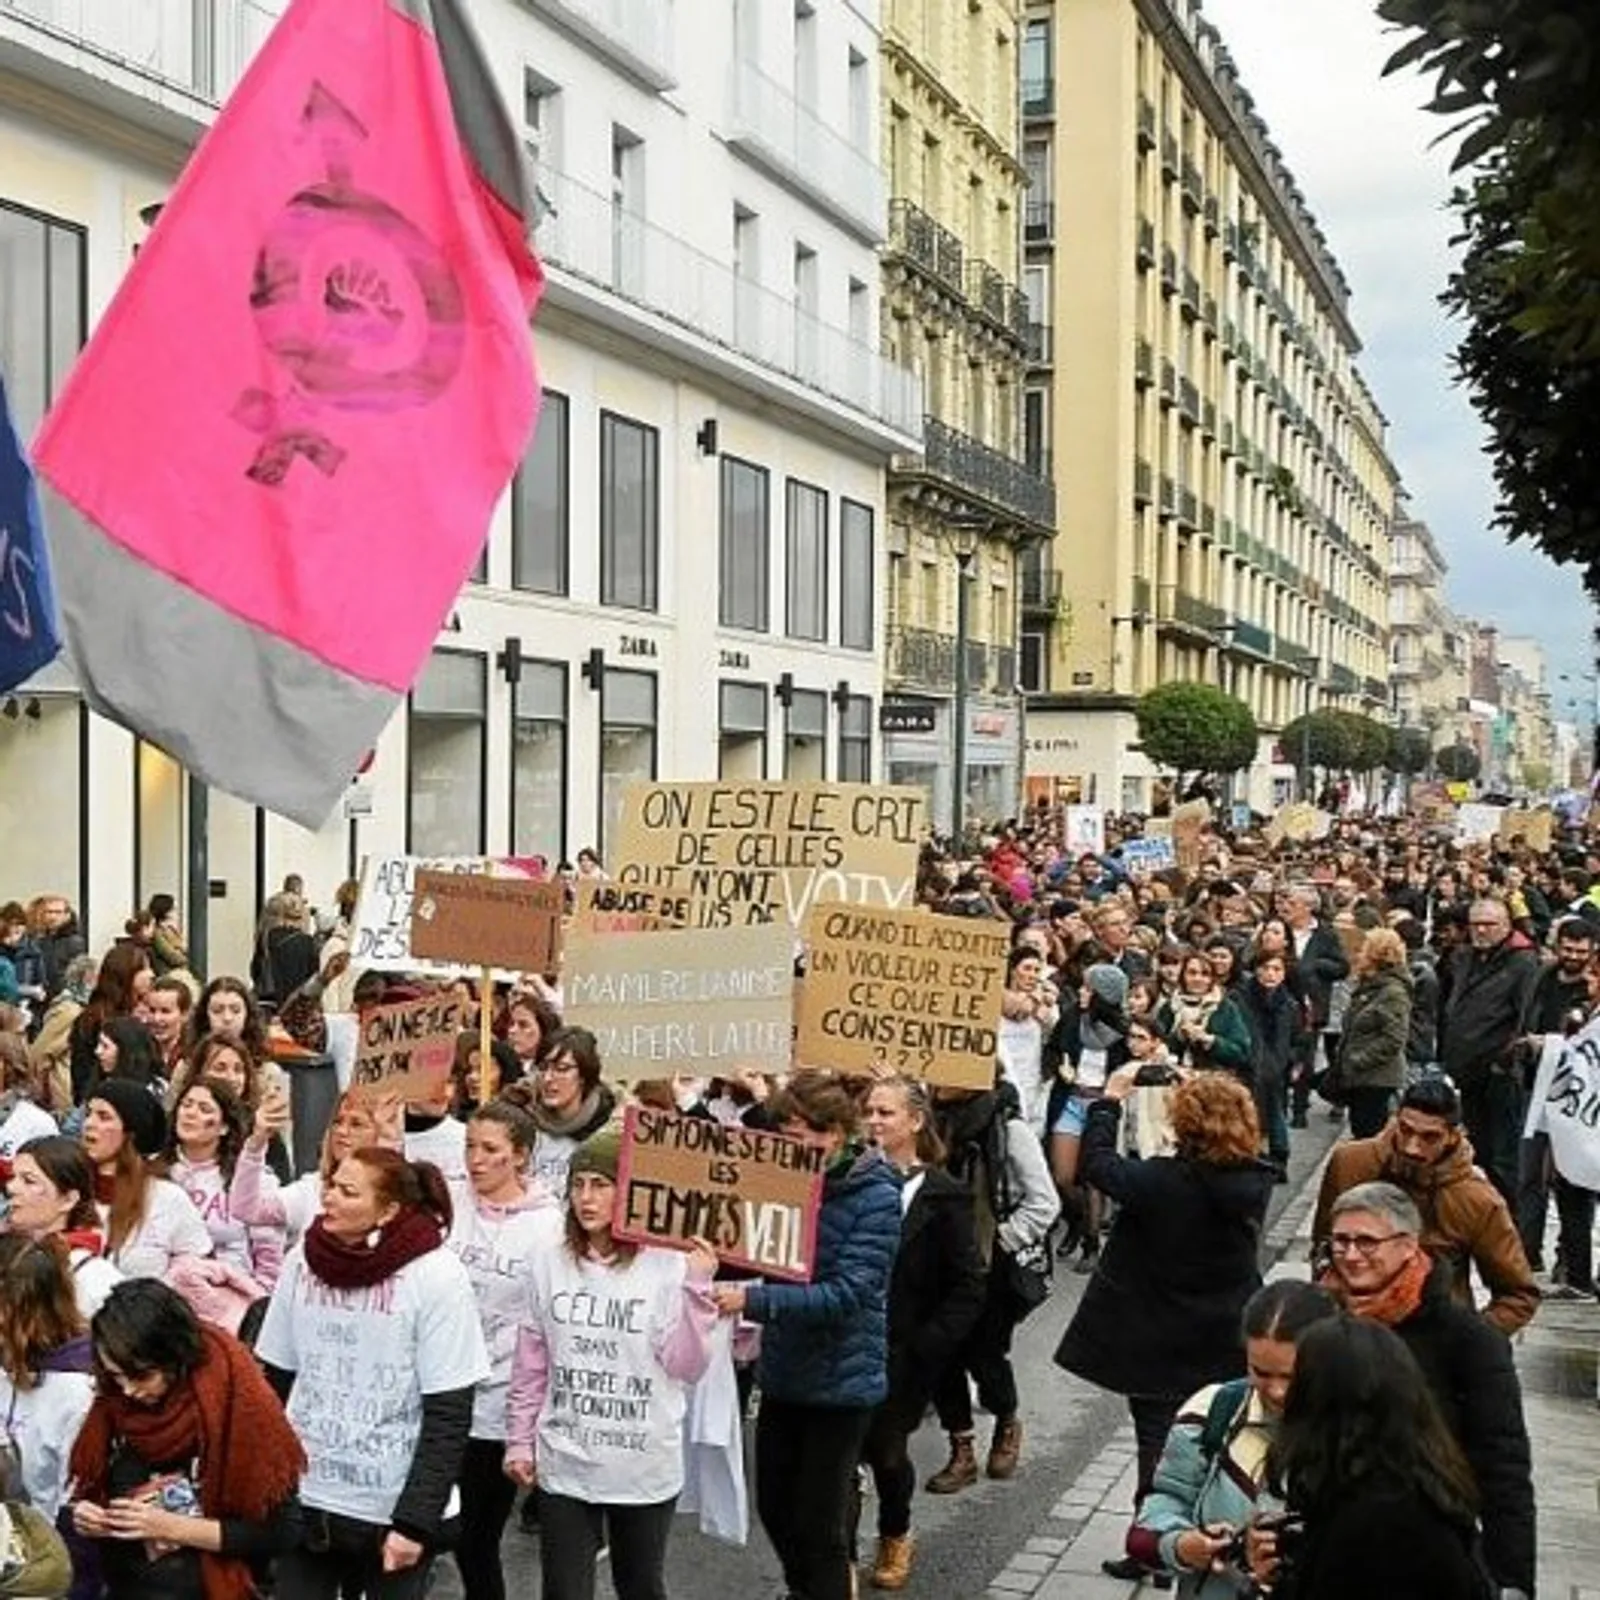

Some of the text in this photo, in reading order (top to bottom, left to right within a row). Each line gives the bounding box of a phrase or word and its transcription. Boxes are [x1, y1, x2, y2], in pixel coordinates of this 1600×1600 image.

[619, 635, 658, 658] ZARA
[718, 650, 750, 670] ZARA
[883, 716, 932, 728] ZARA
[643, 789, 922, 844] ON EST LE CRI
[675, 833, 844, 869] DE CELLES
[590, 887, 655, 914] ABUSE
[660, 897, 689, 920] DE
[690, 869, 776, 904] N'ONT
[824, 912, 898, 945] QUAND
[902, 924, 924, 949] IL
[811, 948, 997, 992] UN VIOLEUR EST
[848, 982, 987, 1021] CE QUE LE
[707, 1160, 742, 1185] LES
[625, 1178, 807, 1273] FEMMES VEIL
[551, 1285, 648, 1334] CÉLINE
